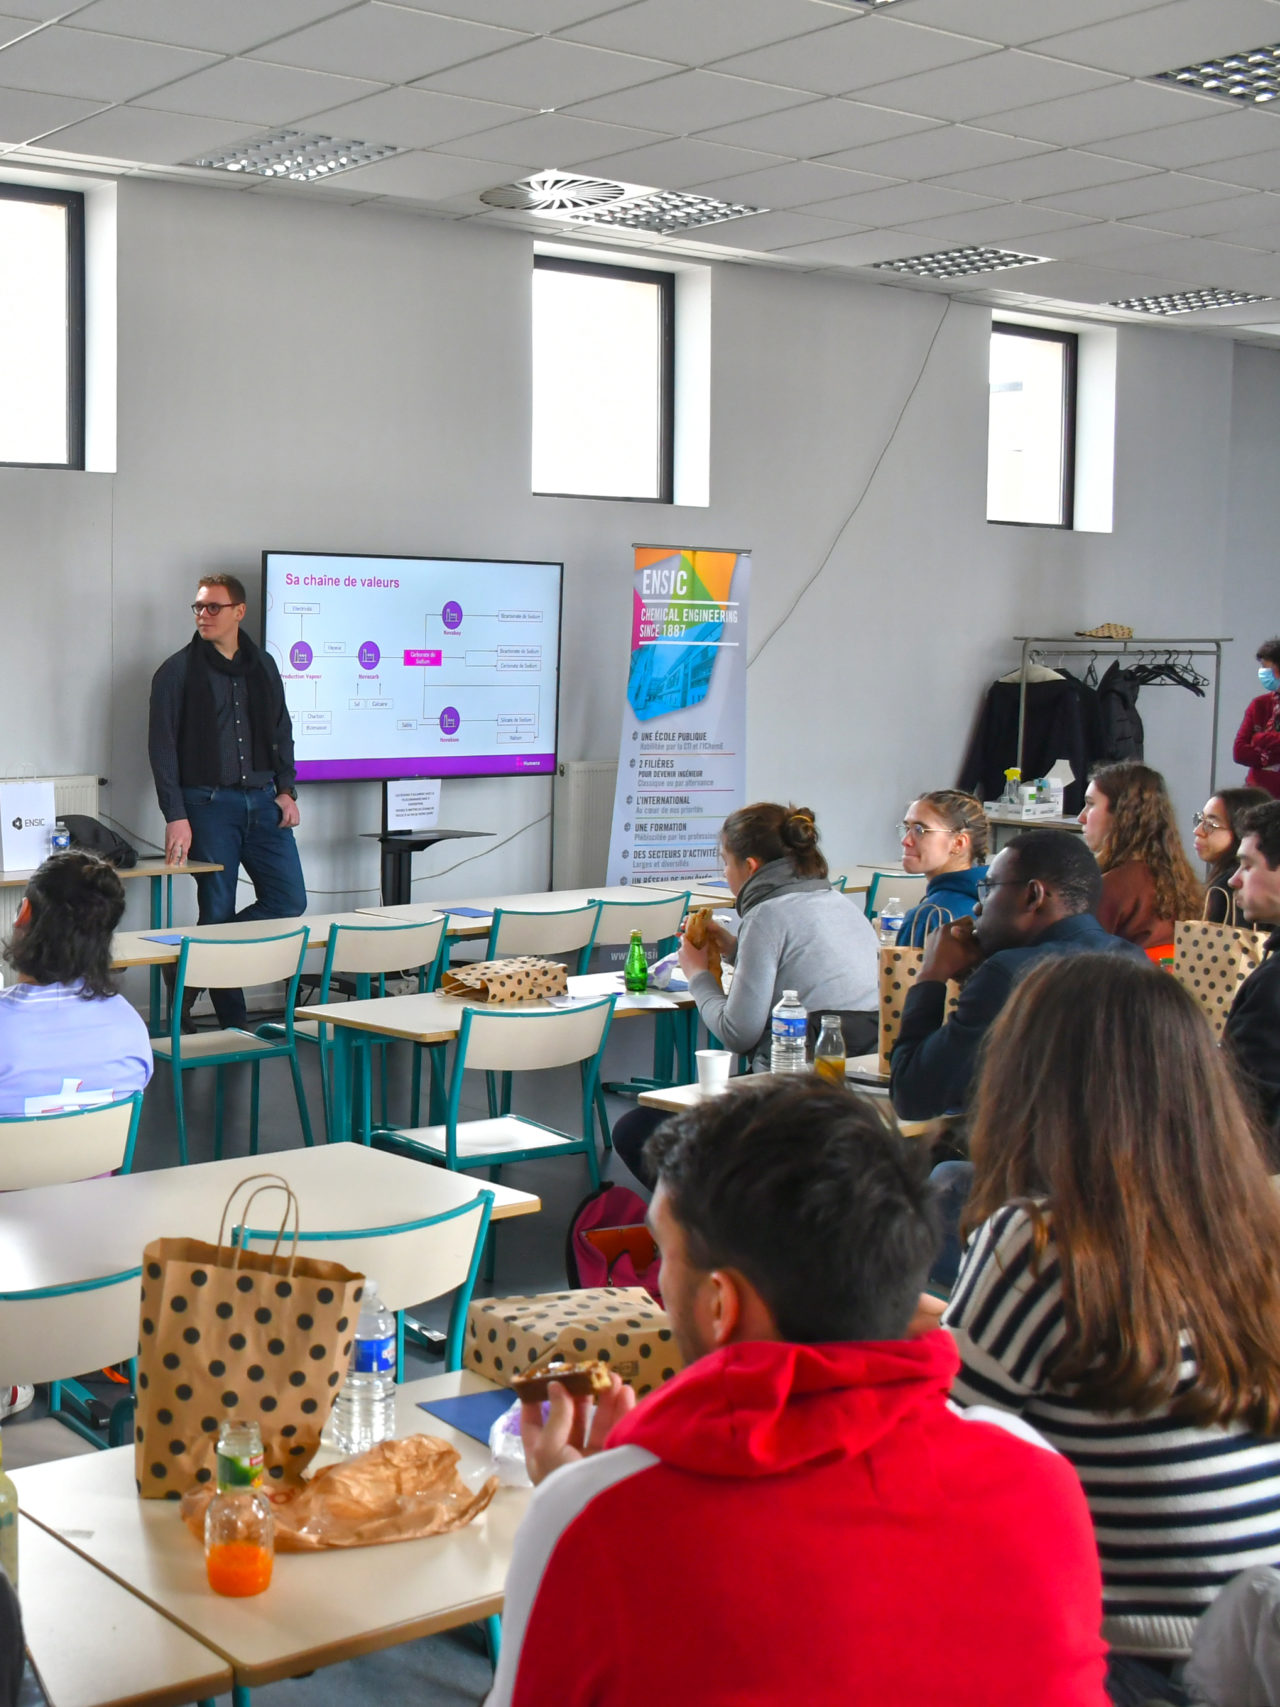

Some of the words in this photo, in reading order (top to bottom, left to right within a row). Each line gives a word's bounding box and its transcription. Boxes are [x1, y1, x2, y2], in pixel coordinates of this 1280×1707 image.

[285, 573, 300, 585] Sa
[303, 574, 340, 587] chaîne
[344, 575, 357, 587] de
[360, 576, 400, 588] valeurs
[642, 569, 688, 595] ENSIC
[640, 608, 679, 621] CHEMICAL
[682, 608, 738, 623] ENGINEERING
[639, 624, 660, 637] SINCE
[662, 624, 686, 637] 1887
[641, 732, 653, 741] UNE
[654, 731, 676, 741] ÉCOLE
[677, 731, 707, 741] PUBLIQUE
[638, 759, 643, 768] 2
[677, 768, 703, 777] INGÉNIEUR
[636, 795, 690, 805] L'INTERNATIONAL
[24, 818, 45, 828] ENSIC
[634, 823, 647, 832] UNE
[650, 822, 686, 832] FORMATION
[667, 834, 677, 842] par
[633, 850, 646, 859] DES
[648, 849, 681, 859] SECTEURS
